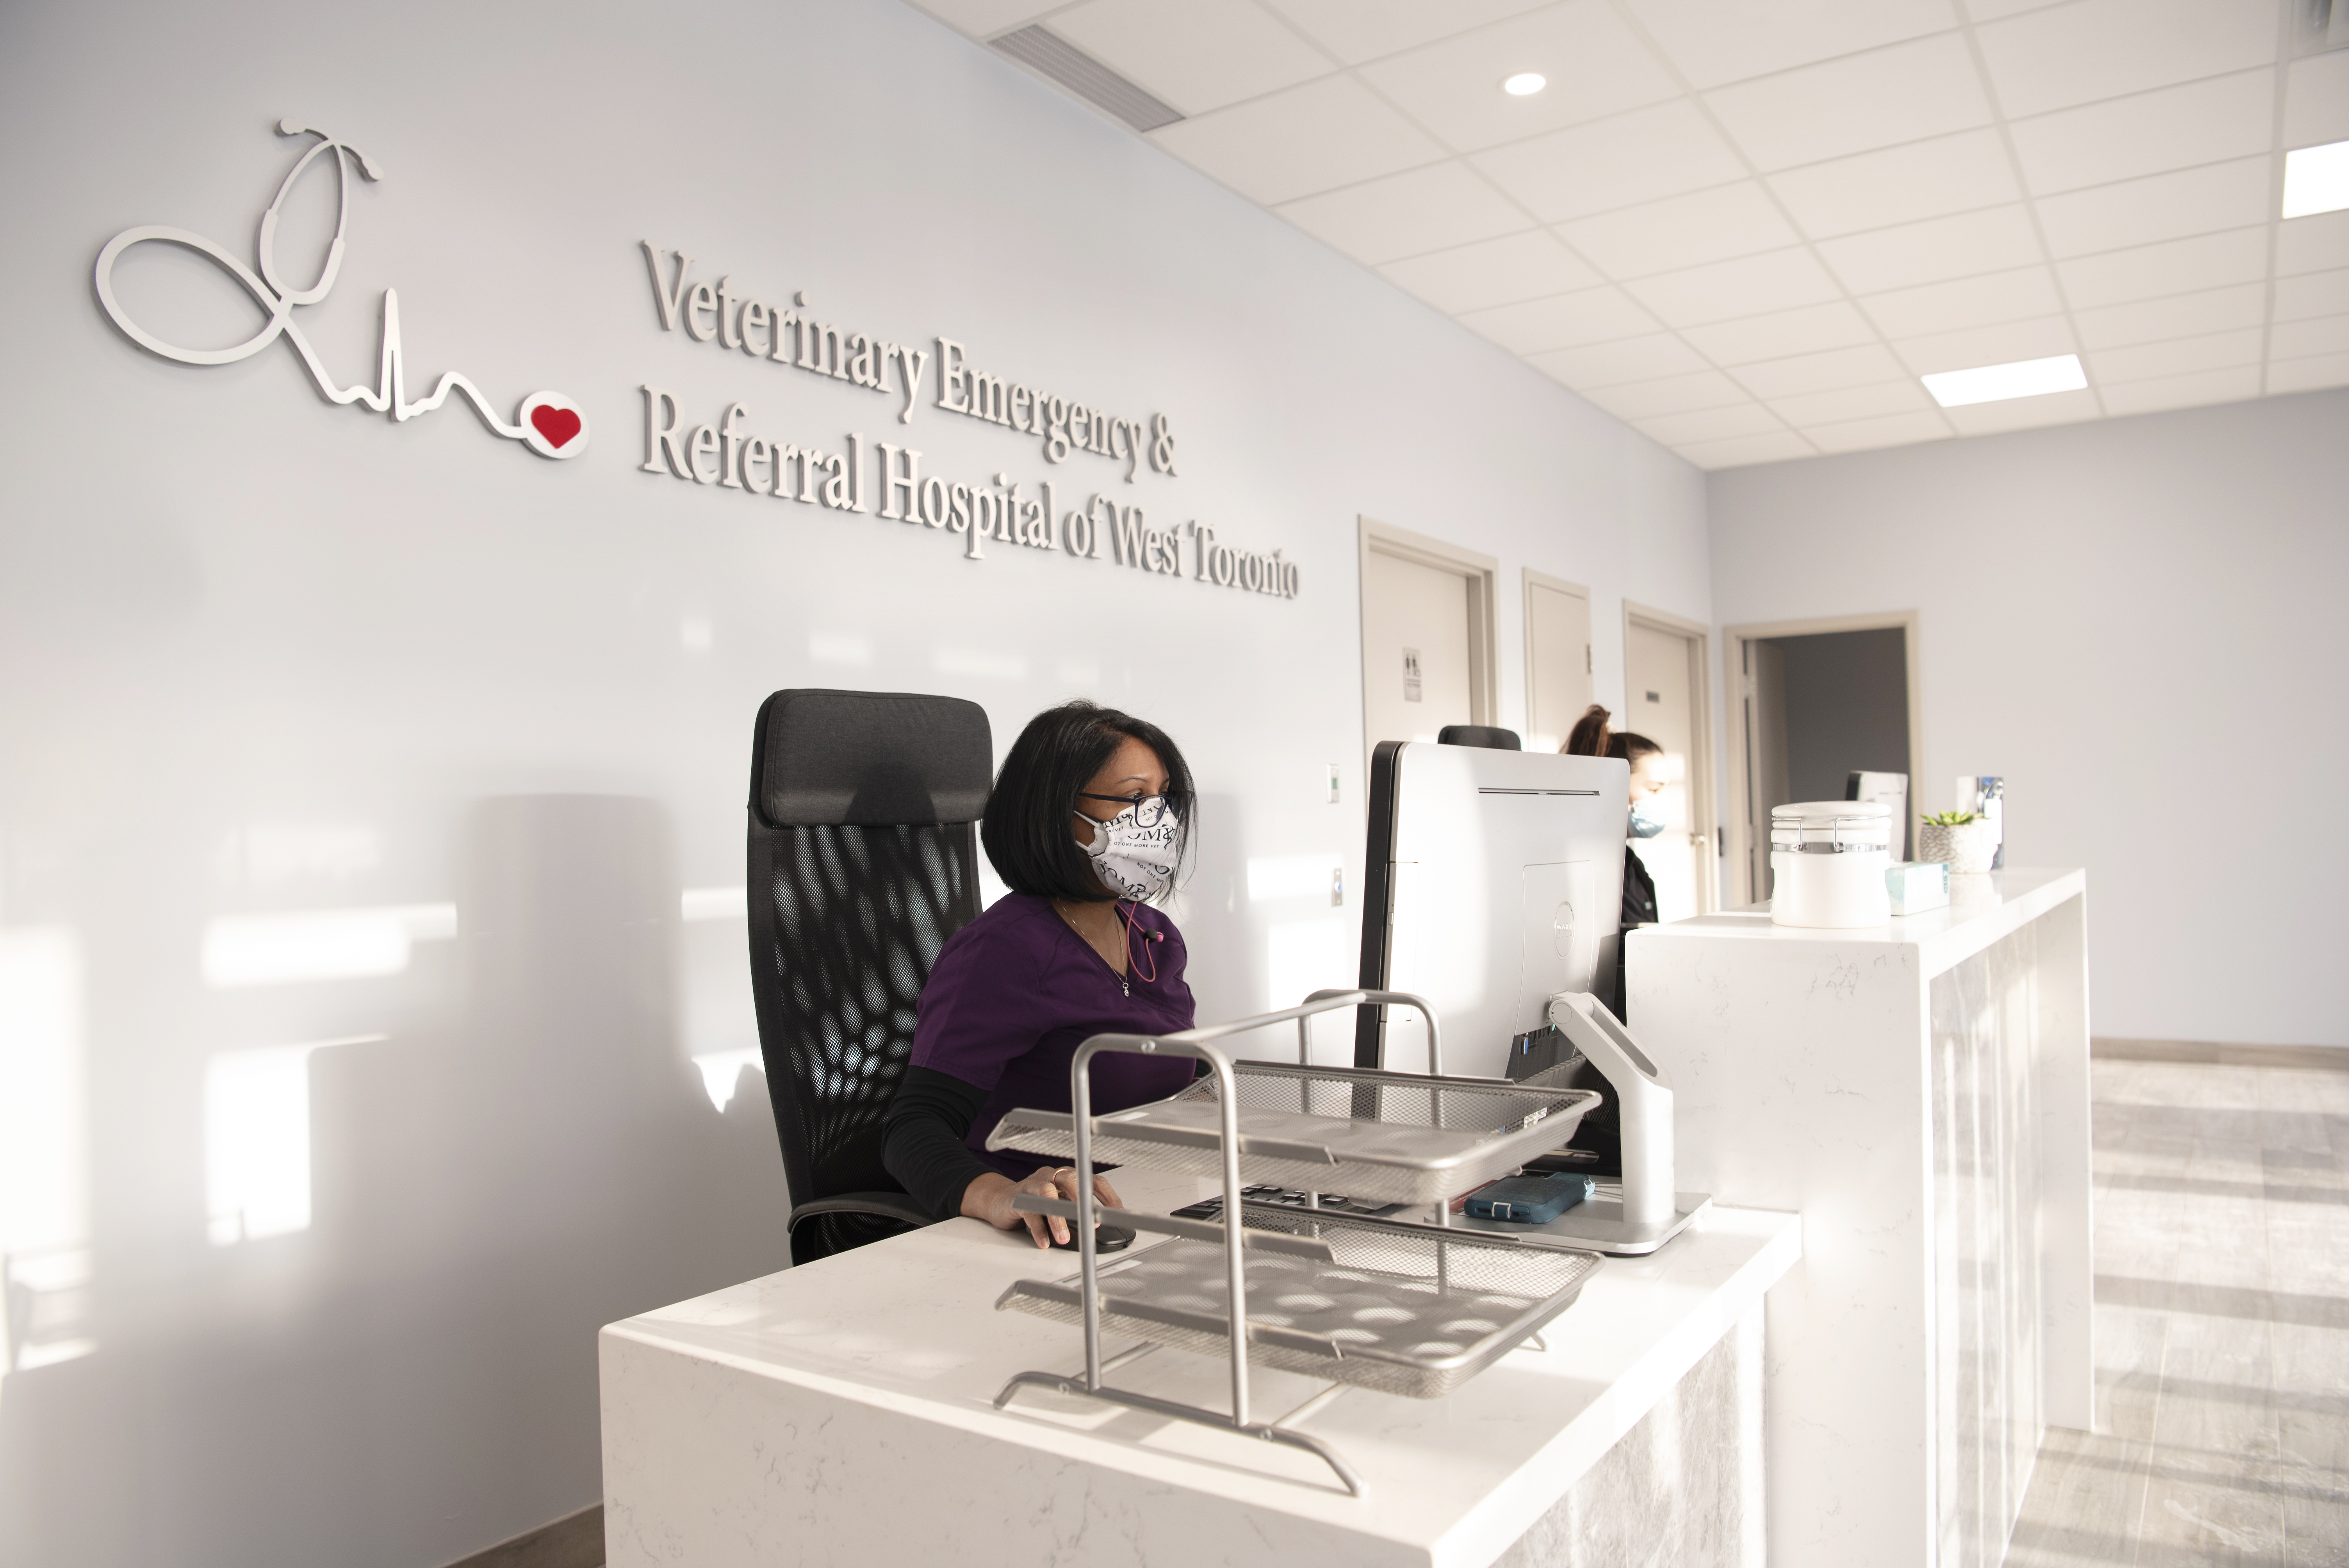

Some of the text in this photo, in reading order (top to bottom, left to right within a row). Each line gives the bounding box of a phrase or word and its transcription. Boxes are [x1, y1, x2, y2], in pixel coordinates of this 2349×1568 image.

[640, 238, 1178, 483] Veterinary Emergency &
[639, 383, 1301, 599] Referral Hospital of West Toronto
[1137, 862, 1146, 870] NOT
[1147, 870, 1156, 878] ONE
[1556, 922, 1573, 939] DELL
